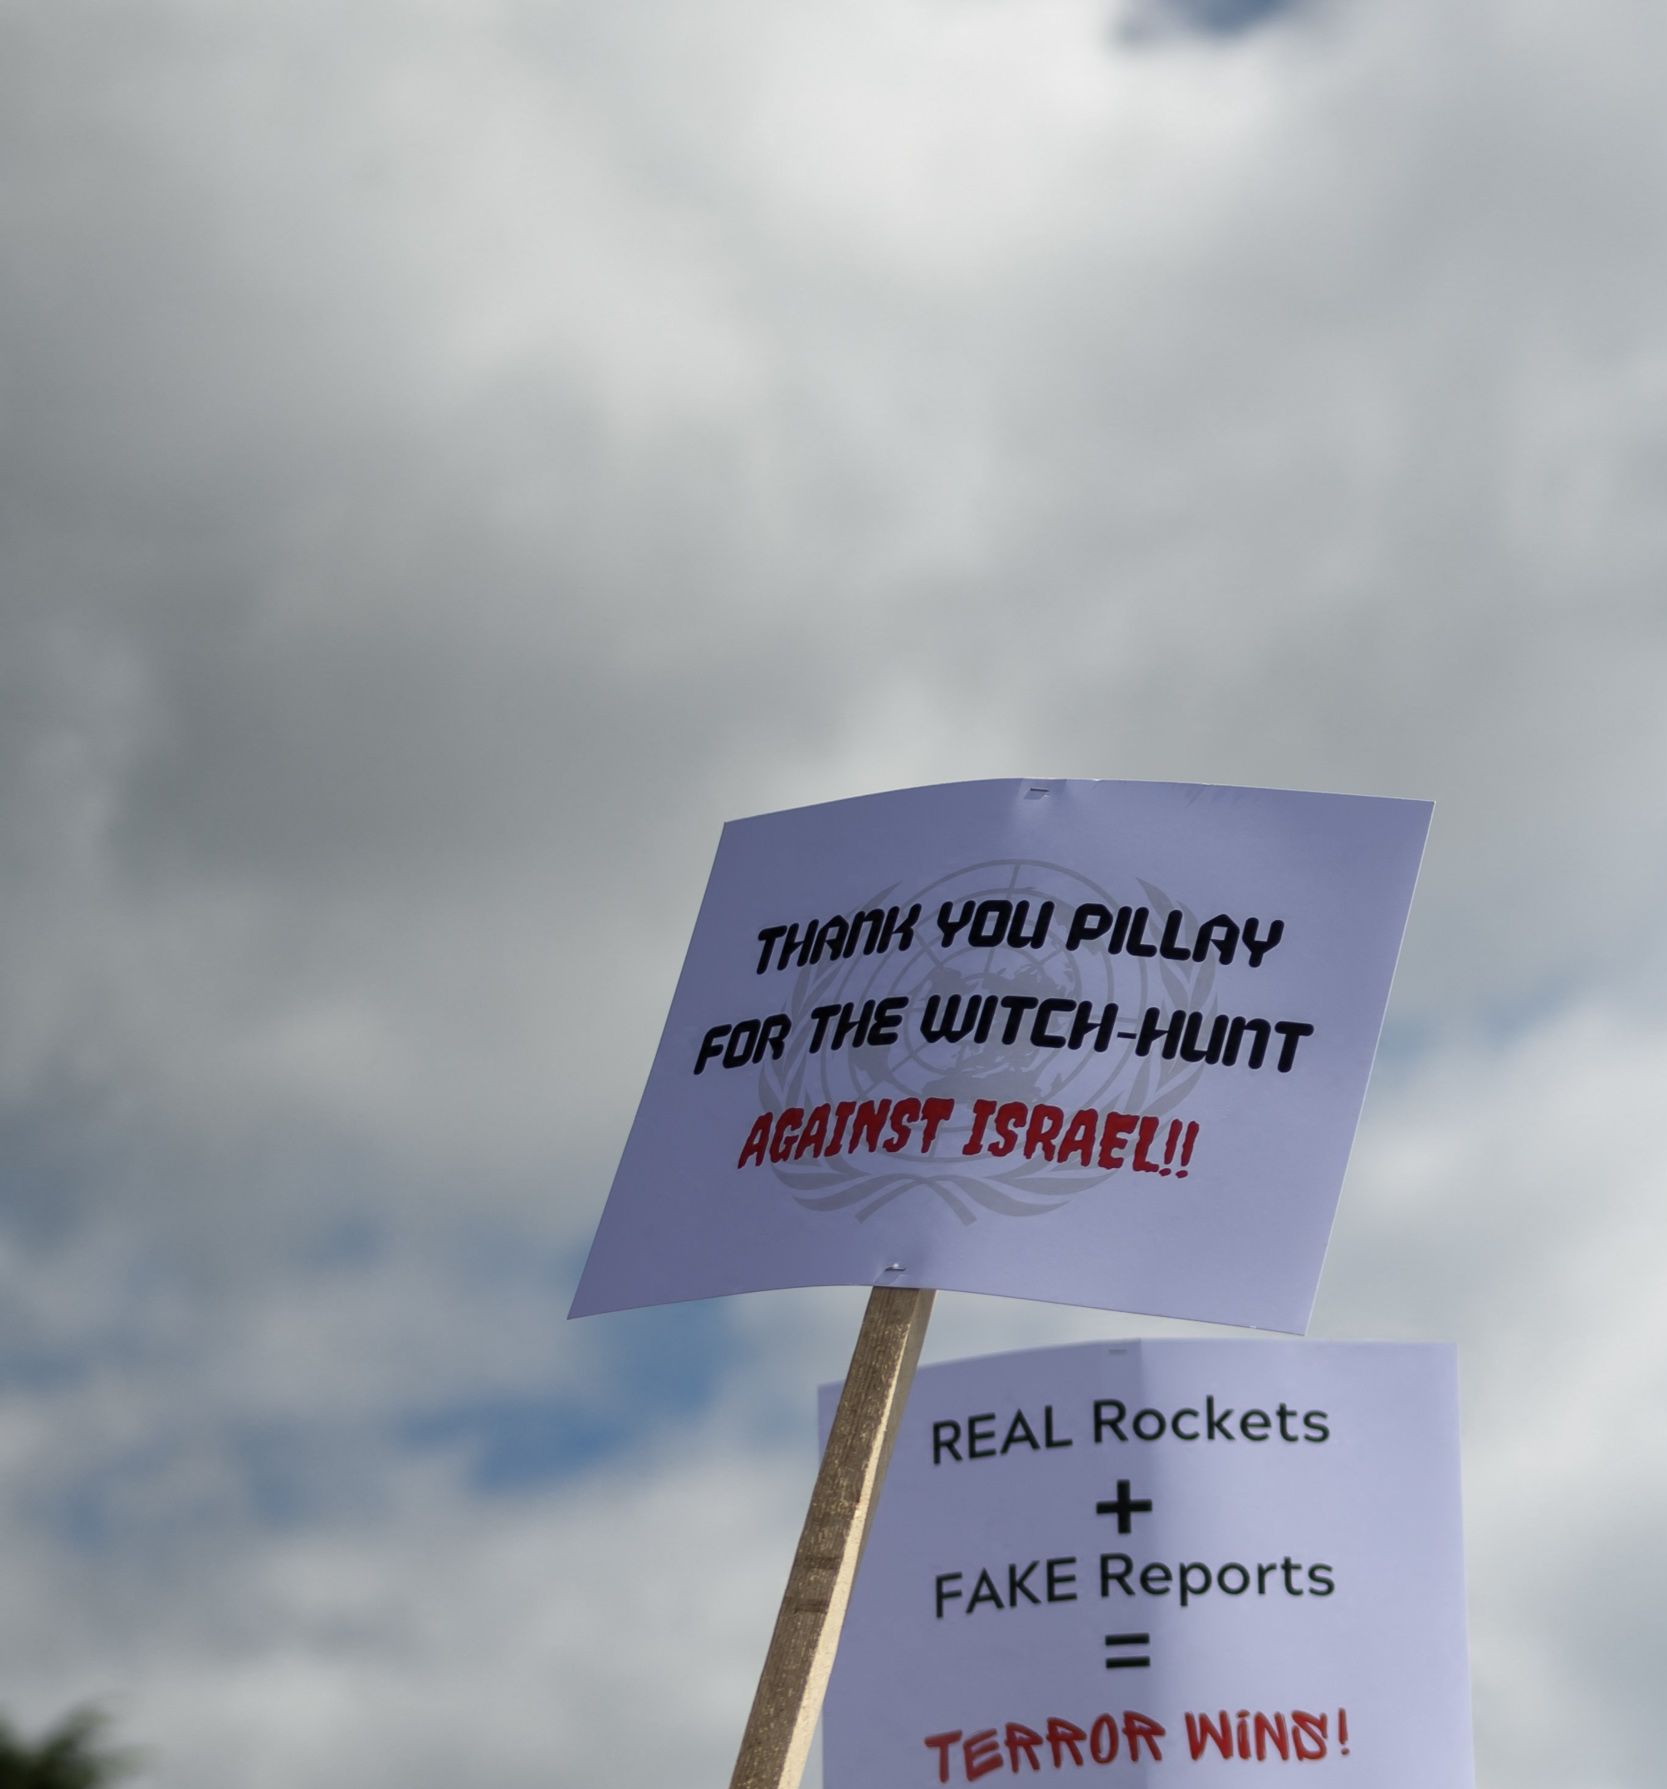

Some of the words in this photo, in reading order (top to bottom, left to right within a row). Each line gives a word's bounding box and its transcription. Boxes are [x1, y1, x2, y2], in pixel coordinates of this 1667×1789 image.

[755, 902, 923, 976] THANK
[935, 898, 1056, 951] YOU
[1064, 901, 1286, 969] PILLAY
[692, 1012, 790, 1077] FOR
[809, 998, 905, 1055] THE
[918, 992, 1315, 1074] WITCH-HUNT
[737, 1097, 954, 1169] AGAINST
[962, 1098, 1200, 1179] ISRAEL!!
[931, 1404, 1074, 1466] REAL
[1092, 1395, 1332, 1445] Rockets
[934, 1555, 1079, 1620] FAKE
[1098, 1552, 1337, 1608] Reports
[923, 1709, 1167, 1784] TERROR
